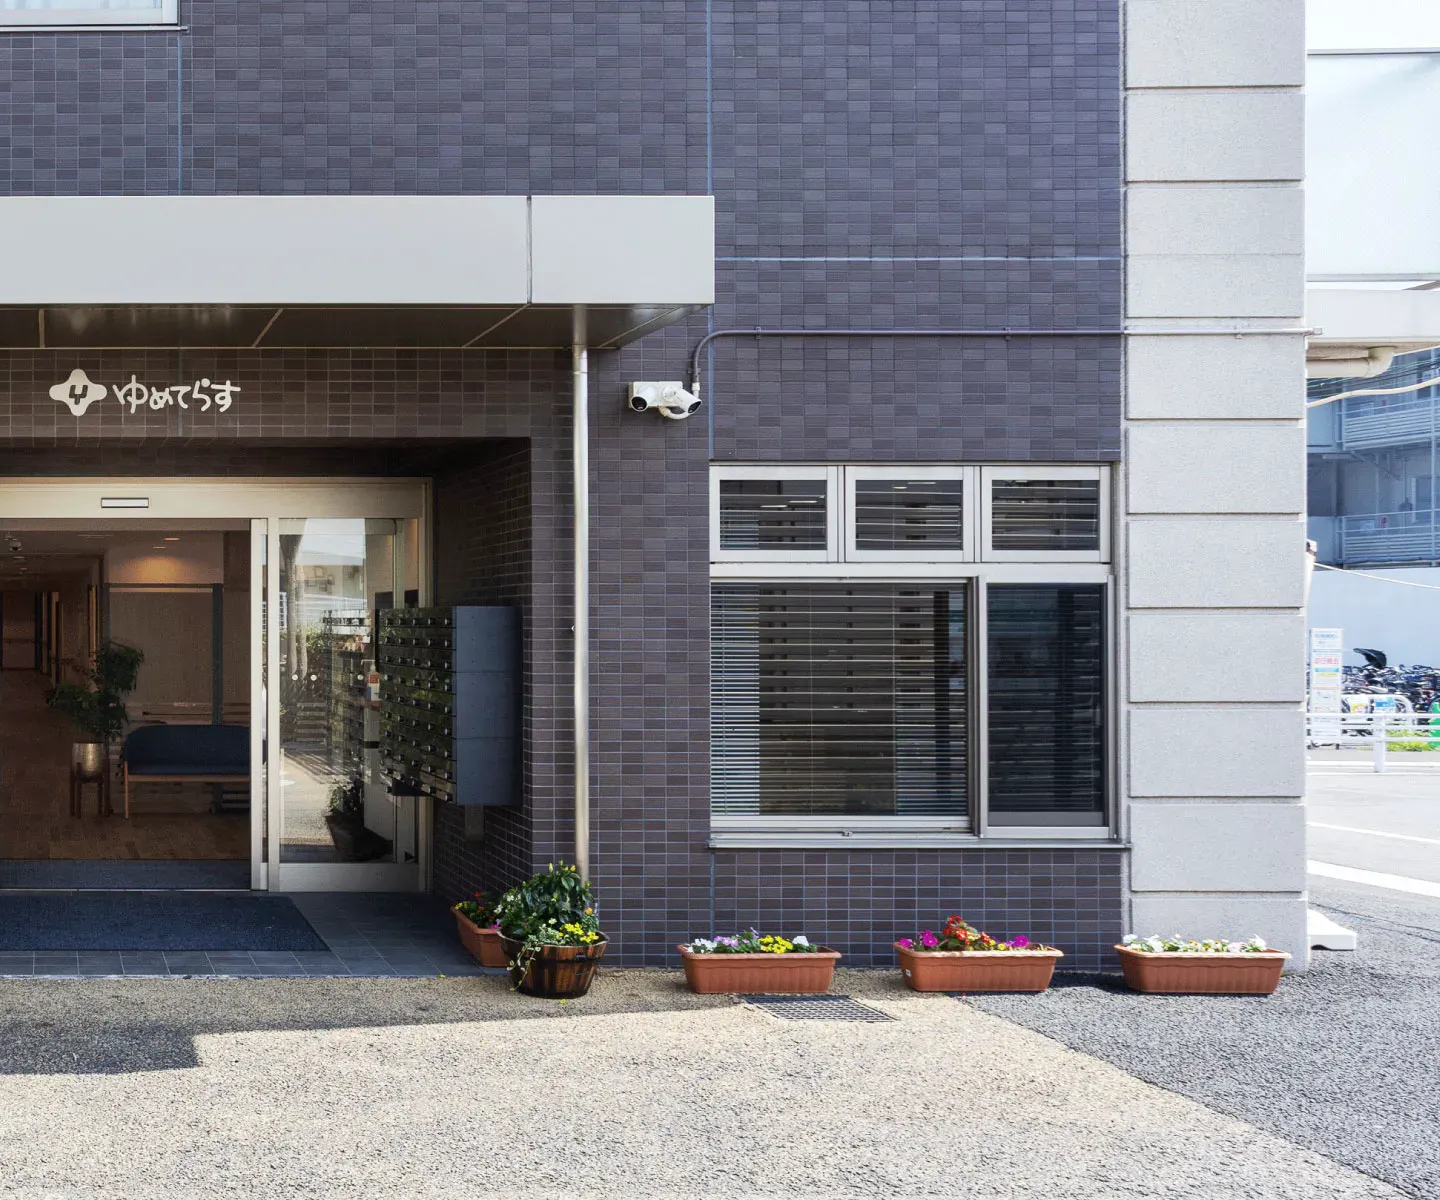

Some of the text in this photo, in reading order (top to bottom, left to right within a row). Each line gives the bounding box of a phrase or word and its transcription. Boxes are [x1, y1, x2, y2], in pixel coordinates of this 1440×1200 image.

[112, 374, 241, 414] ゆめてらす
